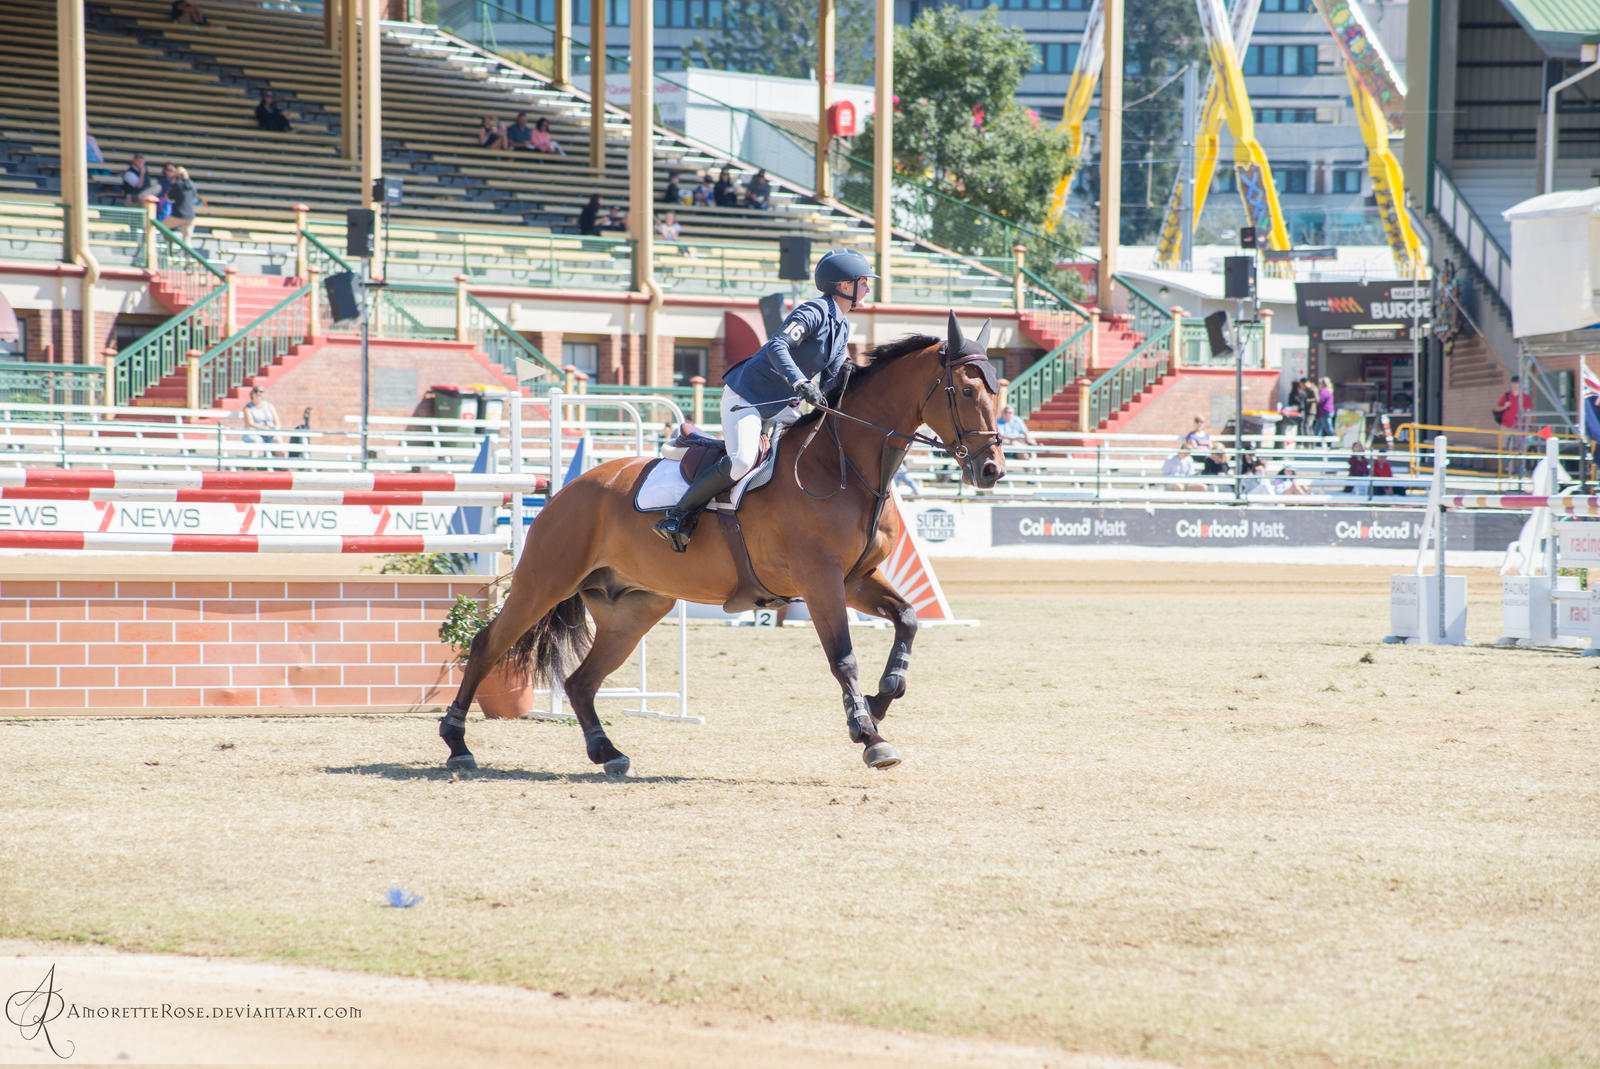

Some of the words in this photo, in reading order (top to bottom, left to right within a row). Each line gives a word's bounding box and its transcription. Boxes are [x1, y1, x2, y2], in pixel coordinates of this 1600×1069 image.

[1370, 301, 1431, 319] BURGE
[783, 321, 805, 342] 16
[0, 505, 58, 526] EWS
[120, 507, 200, 528] NEWS
[260, 508, 337, 530] NEWS
[396, 512, 449, 530] NEW
[917, 514, 955, 527] SUPER
[1020, 516, 1092, 537] Colorbond
[1094, 518, 1127, 538] Matt
[1176, 517, 1250, 538] Colorbond
[1252, 519, 1284, 538] Matt
[1335, 518, 1410, 539] Colorbond
[760, 613, 771, 626] 2
[1570, 601, 1590, 622] raci
